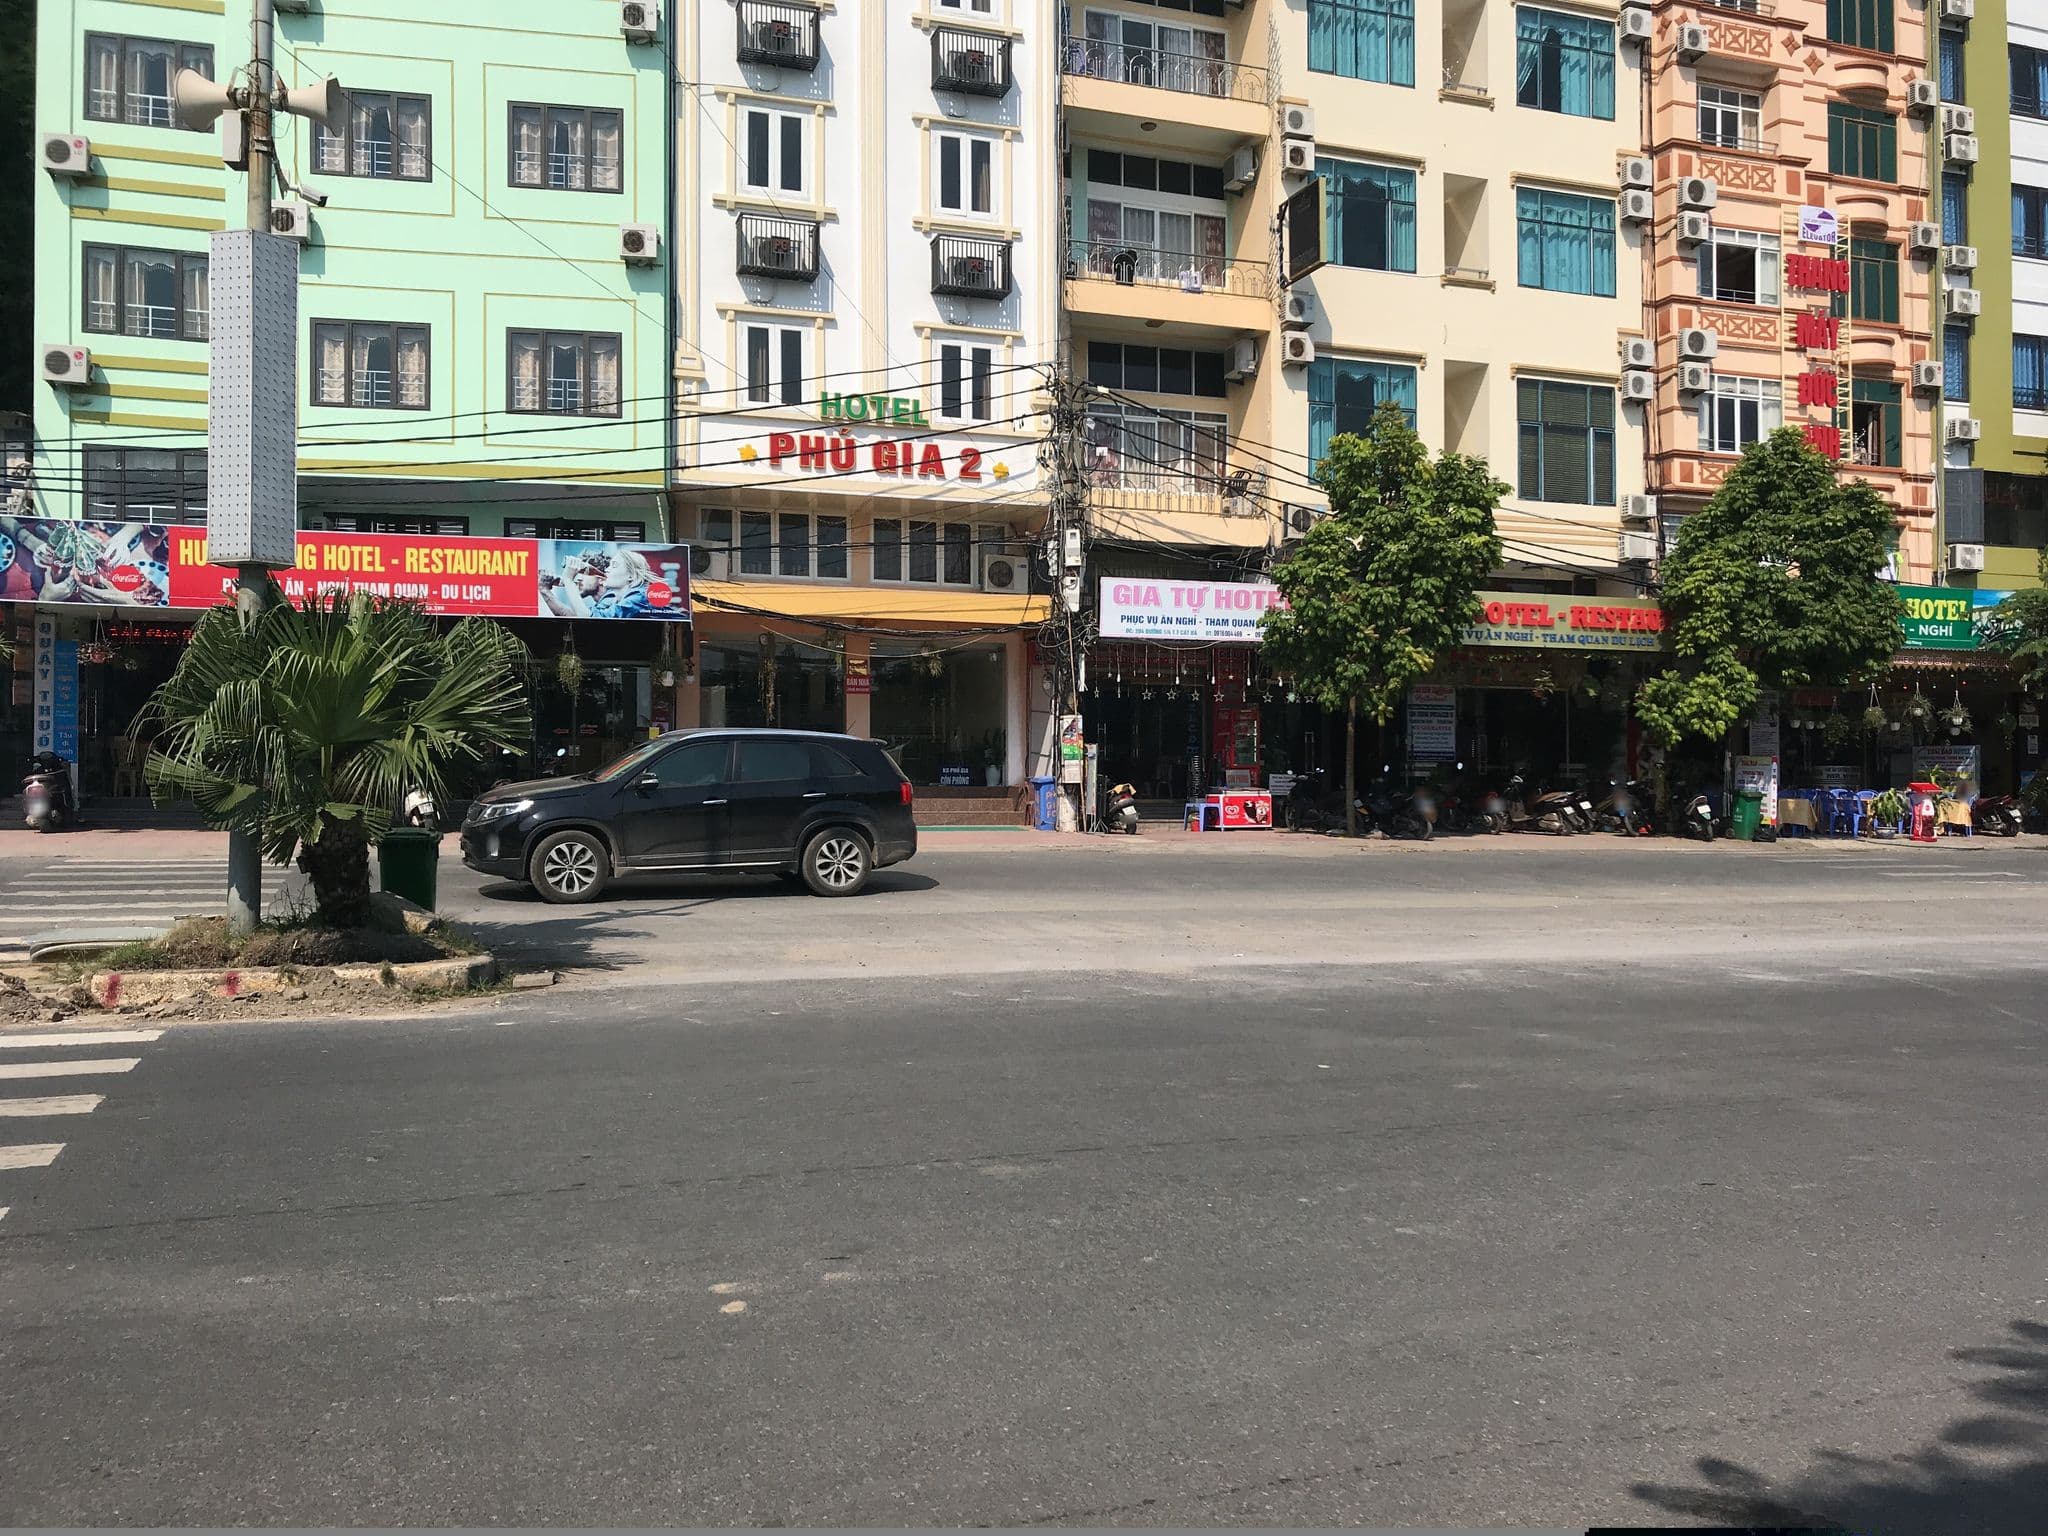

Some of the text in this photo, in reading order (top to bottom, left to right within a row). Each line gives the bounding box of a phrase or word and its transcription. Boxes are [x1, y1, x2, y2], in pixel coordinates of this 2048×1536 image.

[1785, 253, 1850, 293] THANG
[820, 391, 930, 426] HOTEL
[872, 439, 947, 479] GIA
[958, 446, 983, 480] 2
[179, 538, 209, 567] HU
[323, 544, 386, 573] HOTEL
[405, 547, 529, 577] RESTAURANT
[394, 583, 429, 600] QUAN
[441, 584, 459, 600] DU
[462, 585, 491, 604] LỊCH
[1112, 584, 1163, 608] GIA
[1170, 586, 1211, 613] TỰ
[1120, 614, 1144, 627] PHỤC
[1147, 616, 1159, 628] VỤ
[1205, 617, 1230, 628] THAM
[1231, 619, 1256, 629] QUAN
[1480, 601, 1556, 627] OTEL
[1542, 633, 1576, 645] THAM
[1578, 634, 1609, 646] QUAN
[1918, 622, 1953, 637] NGHỈ
[38, 690, 52, 748] THUỐ
